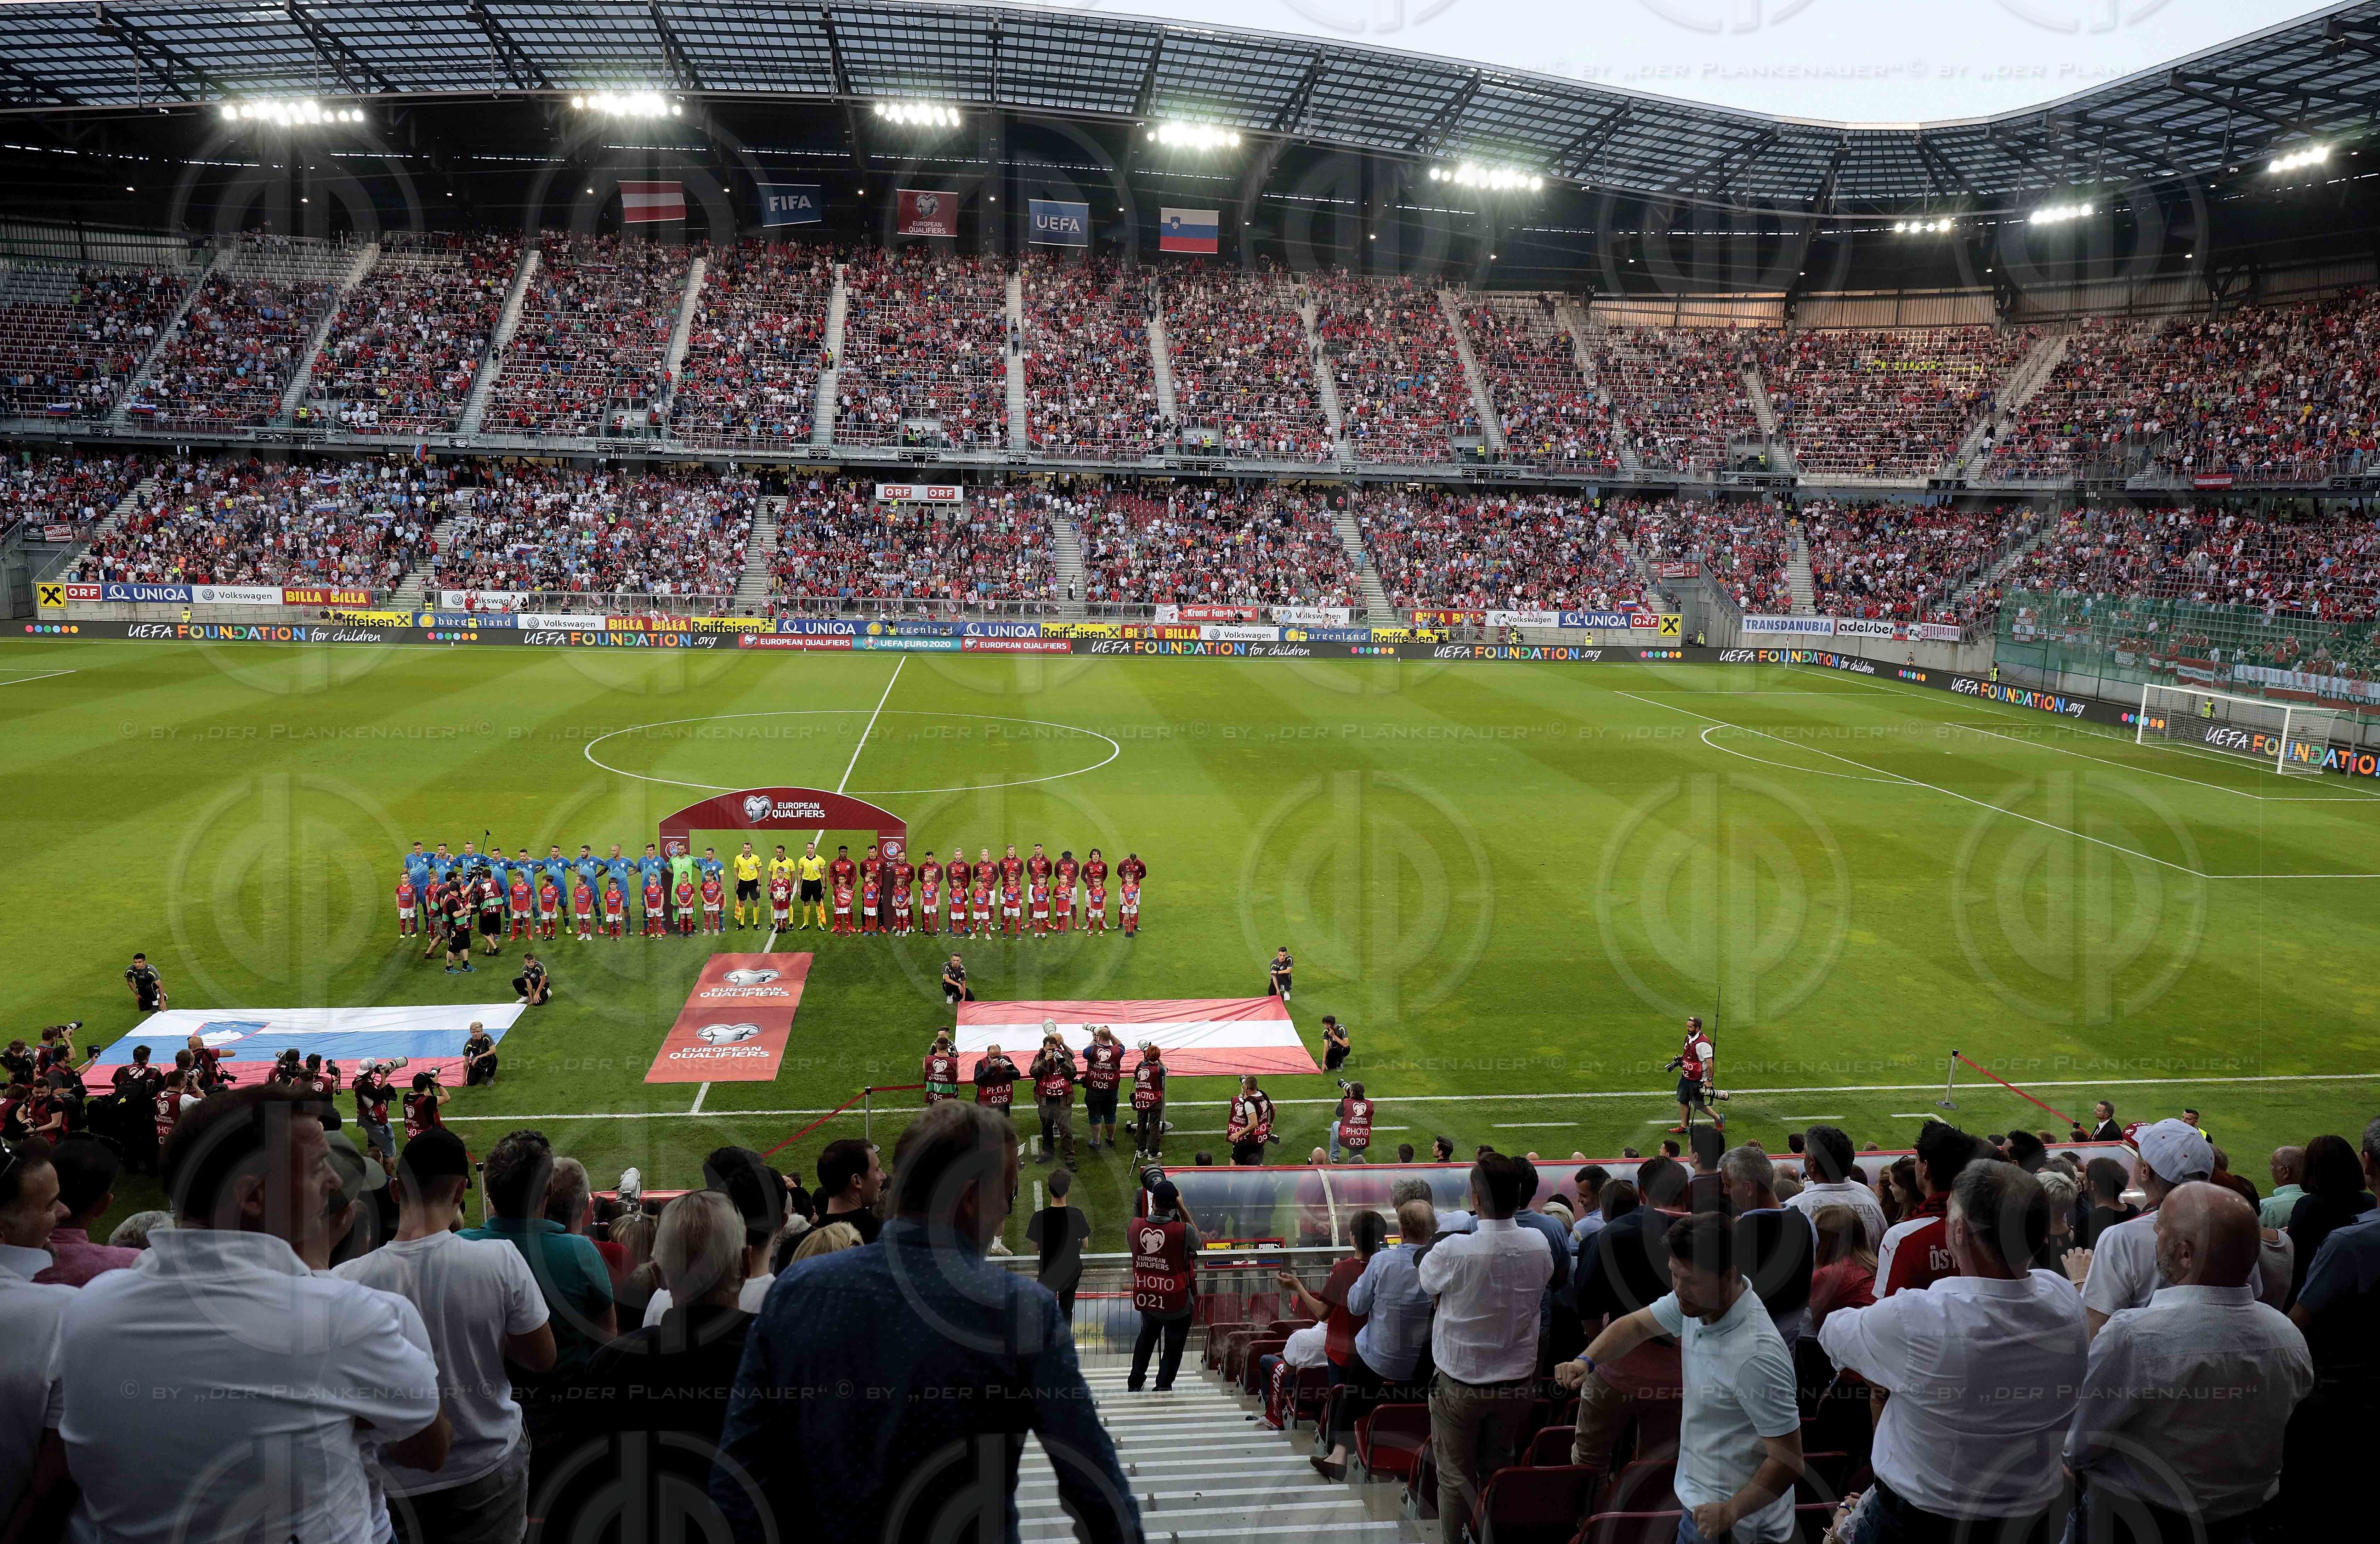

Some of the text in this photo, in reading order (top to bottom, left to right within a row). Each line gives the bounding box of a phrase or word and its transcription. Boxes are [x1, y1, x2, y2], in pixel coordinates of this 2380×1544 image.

[769, 195, 812, 212] FIFA
[1036, 215, 1080, 232] UEFA
[886, 488, 910, 496] ORF
[929, 489, 953, 497] ORF
[45, 527, 71, 536] INSIDER
[1664, 564, 1683, 573] INSIDER
[68, 587, 97, 597] ORF
[134, 587, 189, 601] UNIQA
[219, 591, 272, 601] Volkswagen
[286, 591, 367, 604] BILLA BILLA
[473, 597, 519, 606] olkswagn
[438, 616, 511, 627] burgnland
[544, 619, 595, 629] Volkswagen
[608, 619, 644, 630] BILLA
[1508, 615, 1551, 625] Volkswagen
[1585, 615, 1628, 626] UNIQA
[692, 622, 760, 633] Raiffeisen
[805, 621, 856, 635] UNIQA
[1746, 619, 1831, 632] TRANSDANUBIA
[128, 624, 381, 642] UEFA FOUNDATION for children
[988, 626, 1037, 637] UNIQA
[1042, 626, 1106, 638] Raifeisen
[1165, 628, 1197, 639] BILLA
[1224, 631, 1271, 640] Volkswagen
[524, 631, 717, 648] UEFA FOUNDATION .org
[1309, 632, 1366, 642] urgenland
[760, 638, 850, 647] EUROPEAN QUALIFIERS
[1023, 642, 1067, 650] QUALIFIERS
[1091, 640, 1310, 657] UEFA FOUNDATION for children
[1434, 646, 1602, 662] UEFA FOUNDATION .org
[1719, 649, 1875, 675] UEFA FOUNDATION for children
[1951, 677, 2086, 718] UEFA FOUNDATION .org
[2205, 726, 2249, 750] UEFA
[777, 802, 820, 810] EUROPEAN
[772, 809, 826, 819] QUALIFIERS
[669, 1051, 770, 1060] QUALIFIERS
[1090, 1070, 1114, 1080] PHOTO
[933, 1083, 942, 1092] TV
[1092, 1080, 1109, 1089] 006
[929, 1092, 943, 1102] 005
[991, 1095, 1008, 1103] 026
[1135, 1091, 1155, 1100] HOTO
[1135, 1100, 1150, 1109] 012
[1346, 1127, 1369, 1135] PHOTO
[1137, 1255, 1166, 1264] EUROPEAN
[1136, 1293, 1165, 1309] 021
